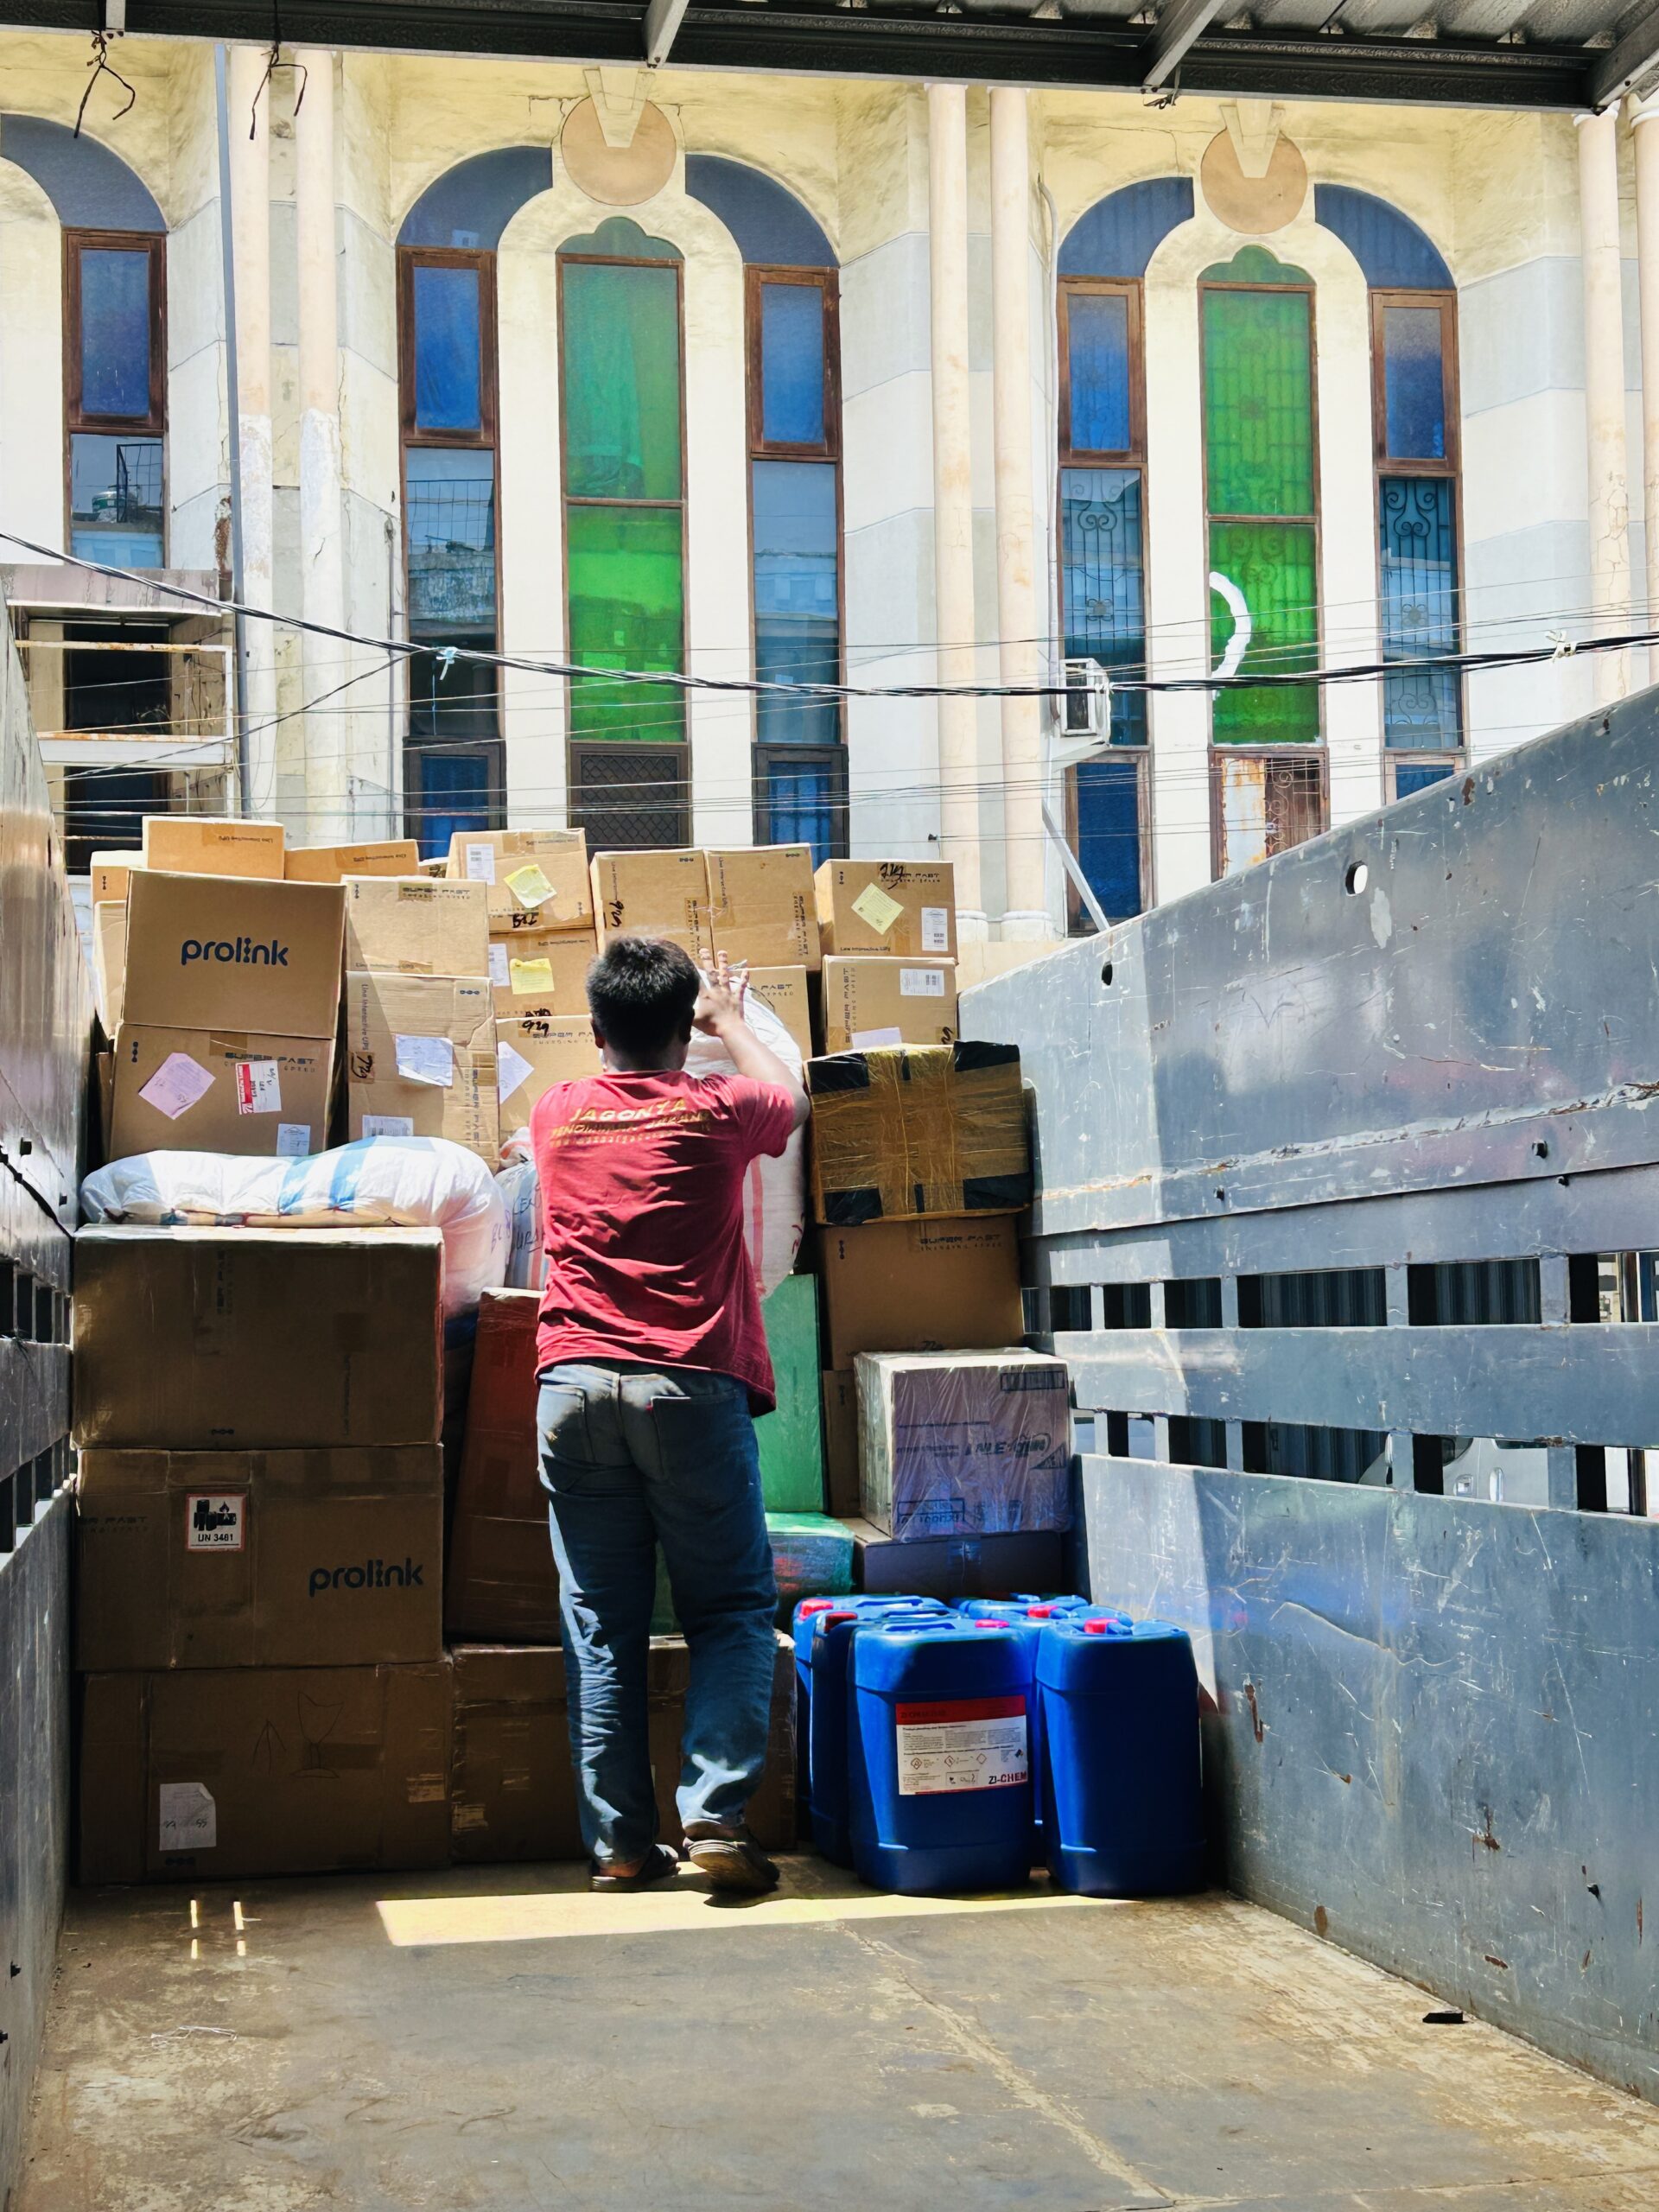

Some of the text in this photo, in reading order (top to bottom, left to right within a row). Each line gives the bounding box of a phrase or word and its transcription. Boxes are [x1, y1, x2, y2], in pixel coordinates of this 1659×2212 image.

[181, 937, 289, 967] prolink
[569, 1096, 687, 1122] JAGONYA
[198, 1534, 211, 1542] UN
[309, 1557, 423, 1599] prolink
[988, 1770, 1027, 1785] ZI-CHEM
